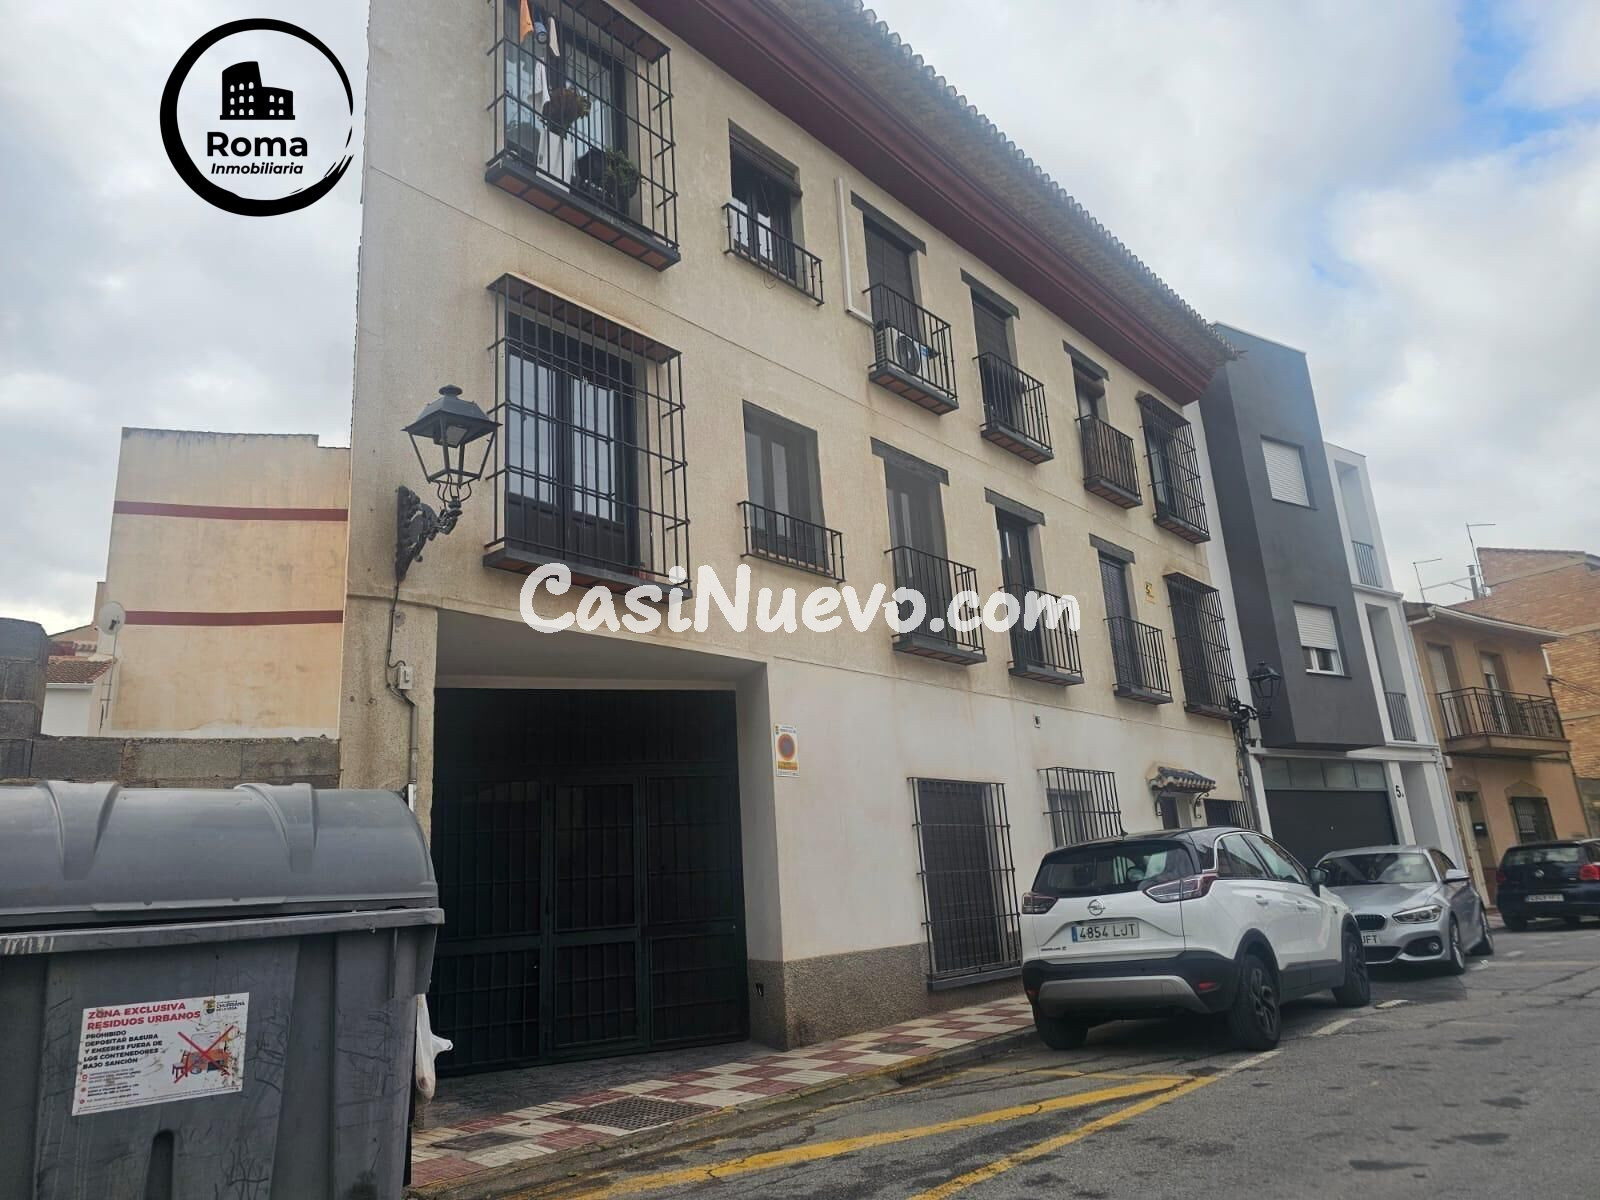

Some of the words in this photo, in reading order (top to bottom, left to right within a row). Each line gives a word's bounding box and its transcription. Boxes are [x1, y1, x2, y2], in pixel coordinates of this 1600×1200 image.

[1080, 925, 1109, 939] 4854
[1113, 923, 1135, 937] LJT
[88, 1009, 121, 1020] ZONA
[124, 1002, 186, 1016] EXCLUSIVA
[87, 1017, 145, 1031] RESIDUOS
[147, 1010, 201, 1024] URBANOS
[85, 1030, 127, 1040] PROHIBIDO
[85, 1037, 127, 1047] DEPOSITAR
[128, 1034, 159, 1042] BASURA
[126, 1042, 151, 1050] FUERA
[99, 1048, 159, 1060] CONTENEDORES
[104, 1057, 138, 1067] SANCIÓN
